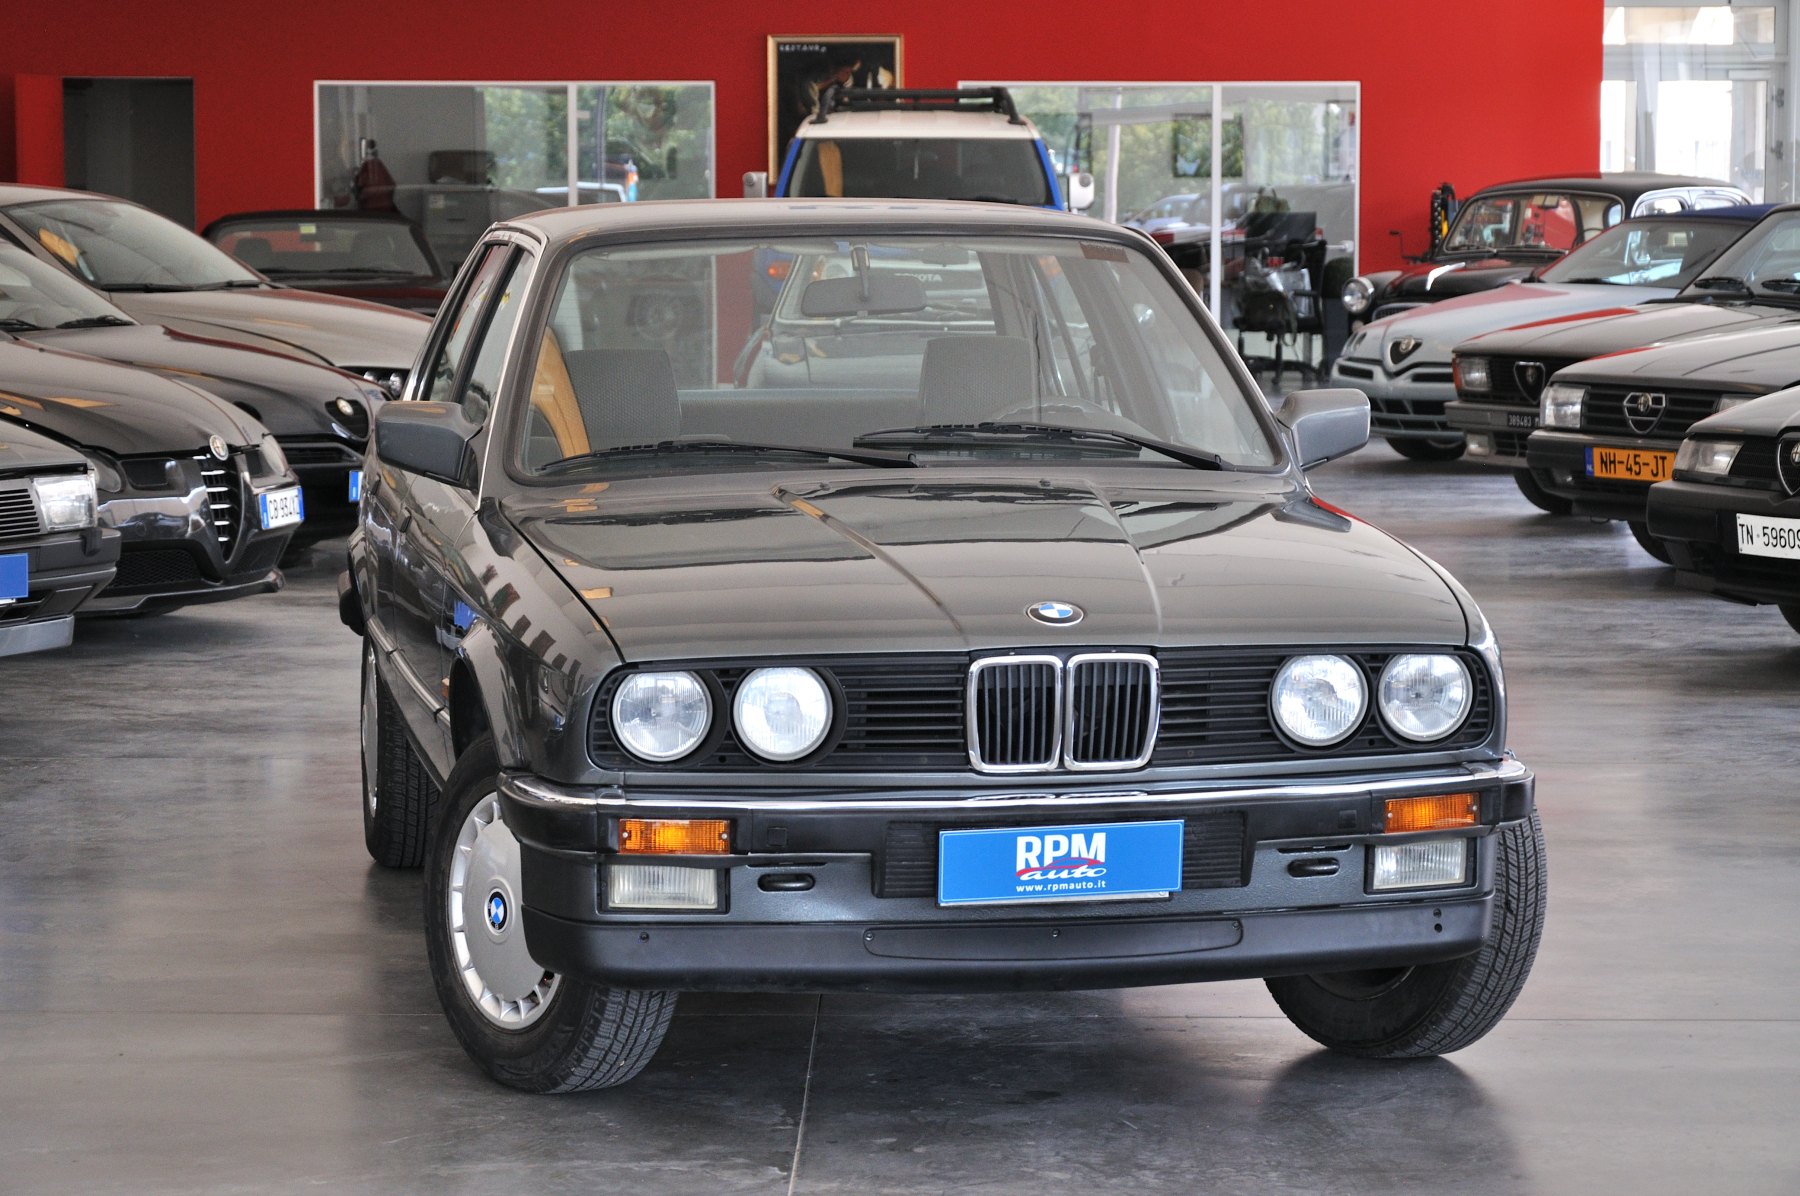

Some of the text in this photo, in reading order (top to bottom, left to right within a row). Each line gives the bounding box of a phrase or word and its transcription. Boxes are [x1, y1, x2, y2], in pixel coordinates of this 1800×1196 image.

[1600, 451, 1667, 478] NH-45-JT
[1738, 523, 1754, 546] TN
[1016, 832, 1106, 873] RPM
[1020, 864, 1107, 881] auto
[1016, 879, 1106, 893] www.rpmauto.it
